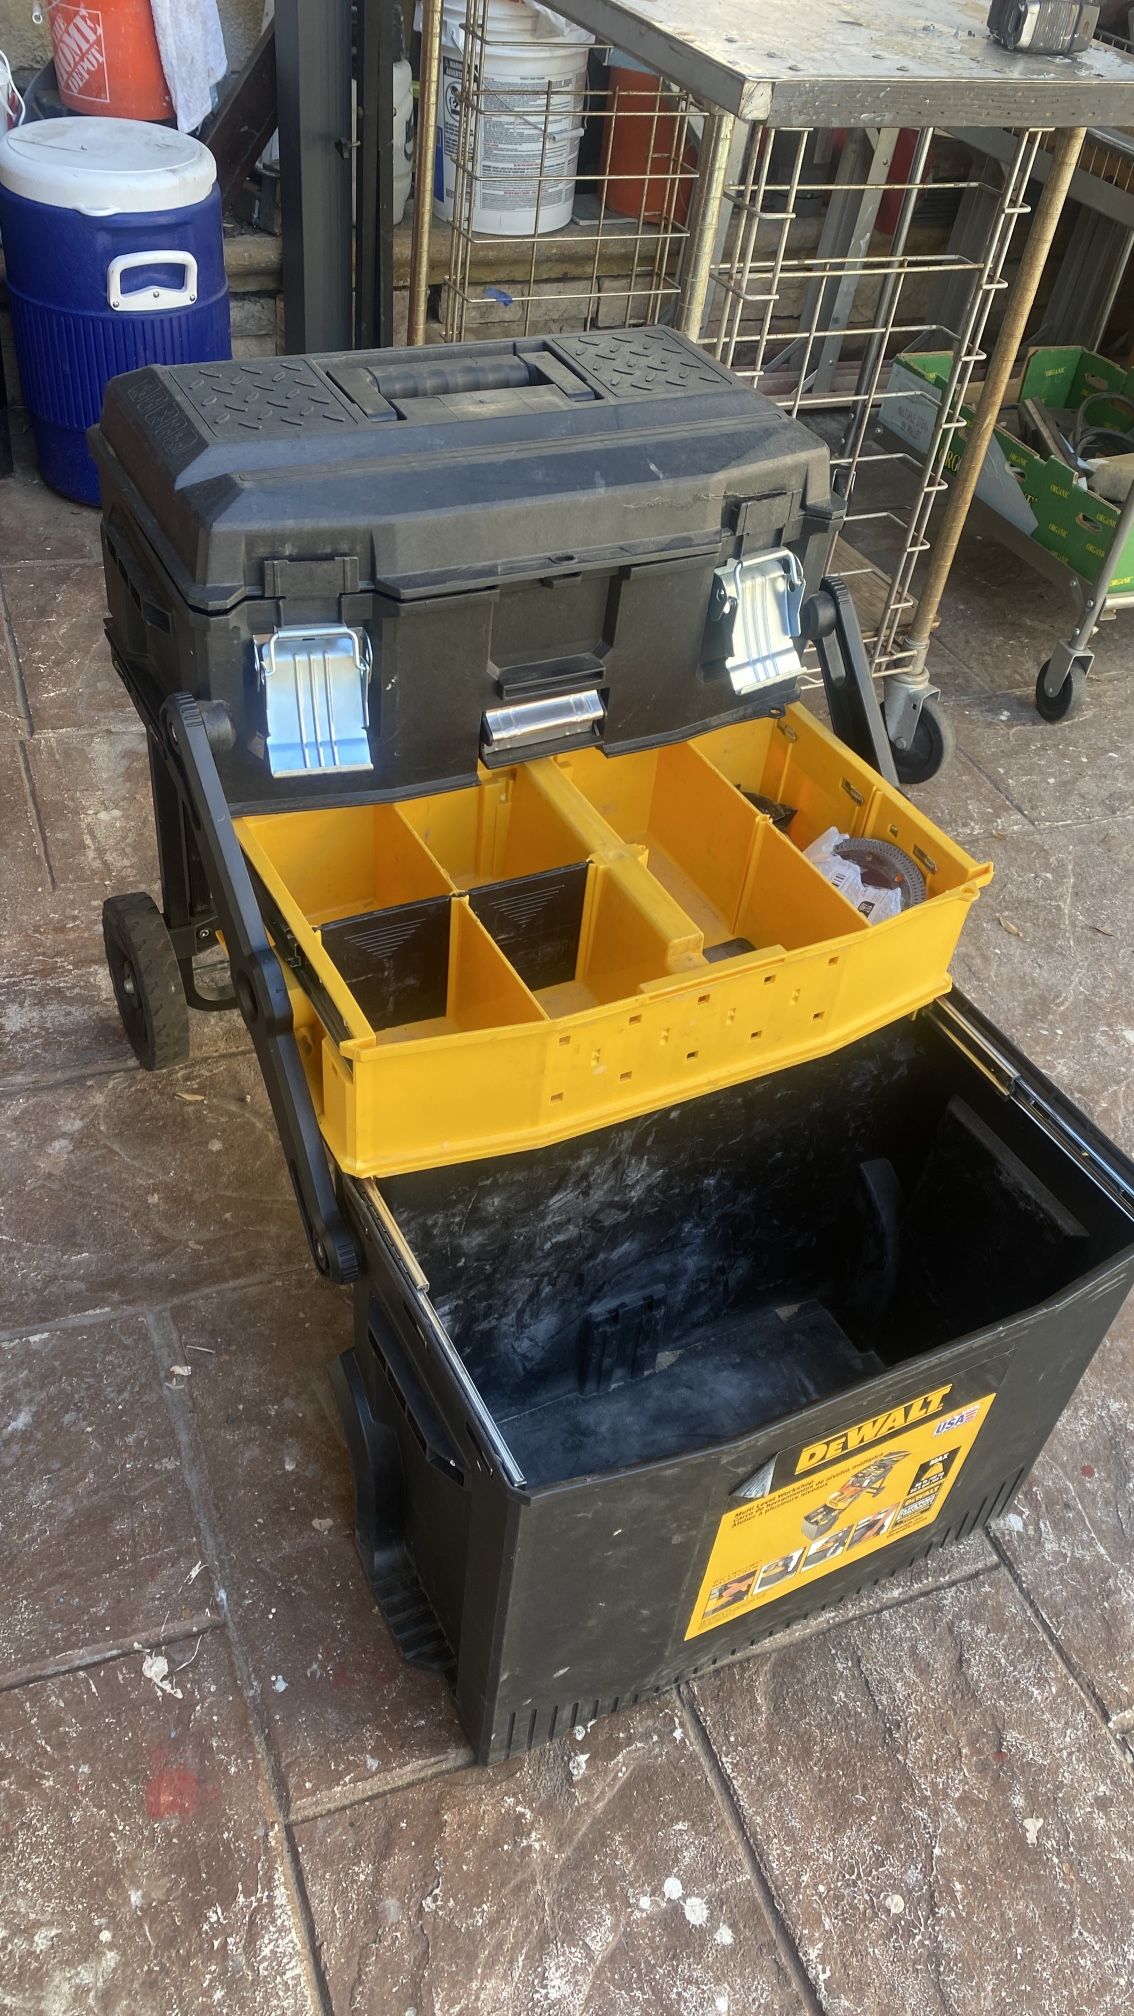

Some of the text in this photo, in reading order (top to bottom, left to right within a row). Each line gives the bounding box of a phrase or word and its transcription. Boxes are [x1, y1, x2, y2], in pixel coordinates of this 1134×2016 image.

[55, 4, 101, 82] HOME
[68, 44, 104, 94] DEPOT
[935, 1414, 965, 1434] USA
[929, 1453, 949, 1466] MAX
[777, 1480, 814, 1499] Workshop
